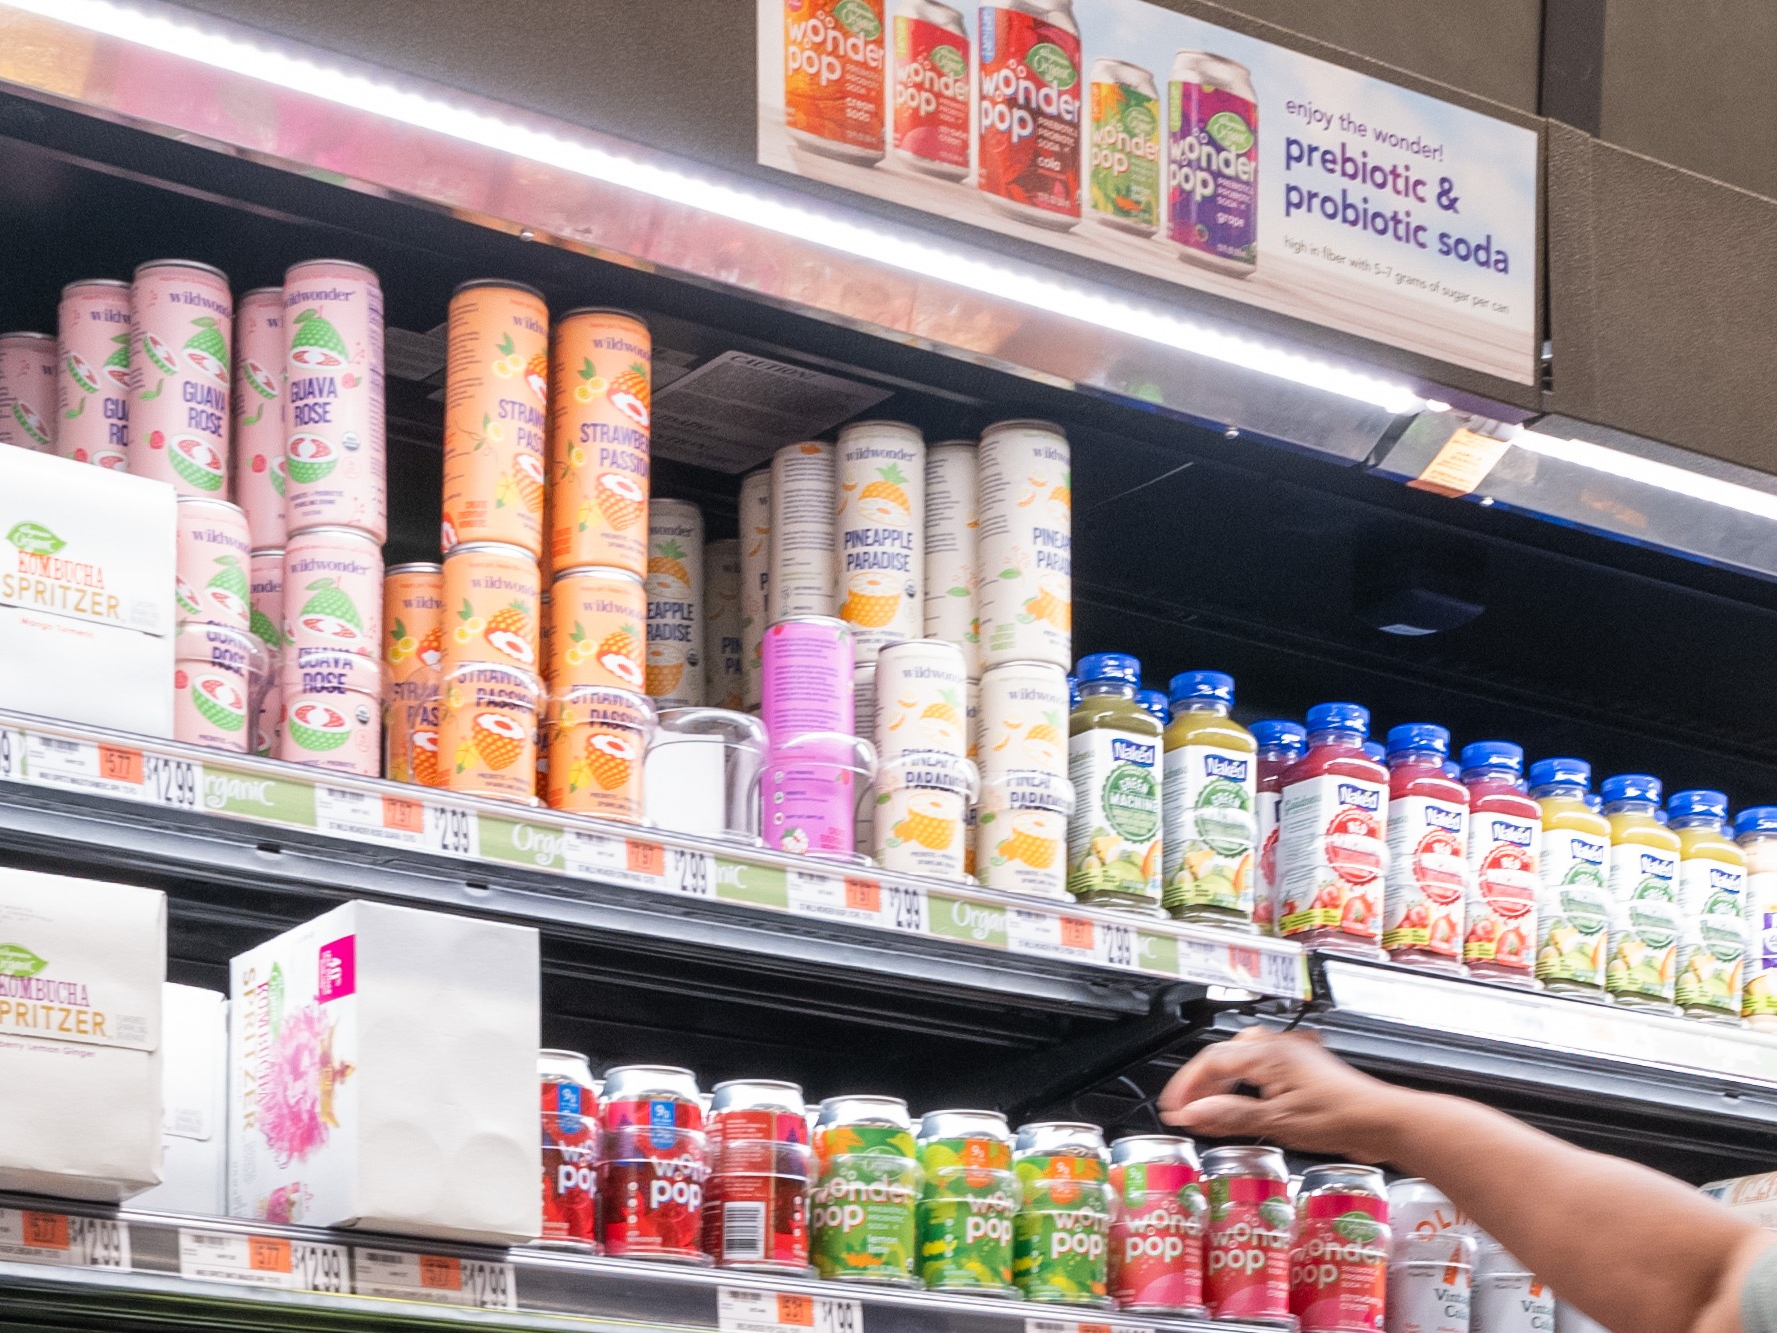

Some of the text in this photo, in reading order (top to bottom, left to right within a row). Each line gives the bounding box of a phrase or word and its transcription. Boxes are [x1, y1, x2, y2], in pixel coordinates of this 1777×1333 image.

[788, 18, 884, 67] wonder
[788, 45, 842, 86] pop
[895, 62, 969, 100] wonder
[894, 84, 937, 117] pop
[981, 67, 1080, 123] wonder
[982, 100, 1034, 144] pop
[1286, 100, 1444, 162] enjoy the wonder!
[1092, 125, 1159, 162] wonder
[1092, 147, 1129, 176] pop
[1170, 134, 1255, 182] wonder
[1170, 163, 1215, 200] pop
[1286, 137, 1460, 214] prebiotic &
[1285, 183, 1510, 275] probiotic soda
[1285, 236, 1307, 254] high
[1310, 245, 1320, 257] in
[1321, 246, 1346, 264] fiber
[1350, 257, 1371, 272] with
[1395, 271, 1427, 289] grams
[1429, 280, 1441, 294] of
[1442, 285, 1470, 303] sugar
[1472, 295, 1489, 308] per
[1492, 302, 1509, 315] can
[291, 377, 339, 404] GUAVA
[294, 401, 333, 425] ROSE
[580, 423, 649, 452] STRAWBE
[844, 443, 917, 465] wildwonder
[843, 528, 914, 552] PINEAPPLE
[17, 550, 105, 591] KOMBUCHA
[846, 550, 912, 574] PARADISE
[2, 572, 120, 622] SPRITZER
[651, 1178, 700, 1209] pop
[966, 1214, 1012, 1246] pop
[1126, 1233, 1182, 1267] pop
[1209, 1243, 1265, 1276] pop
